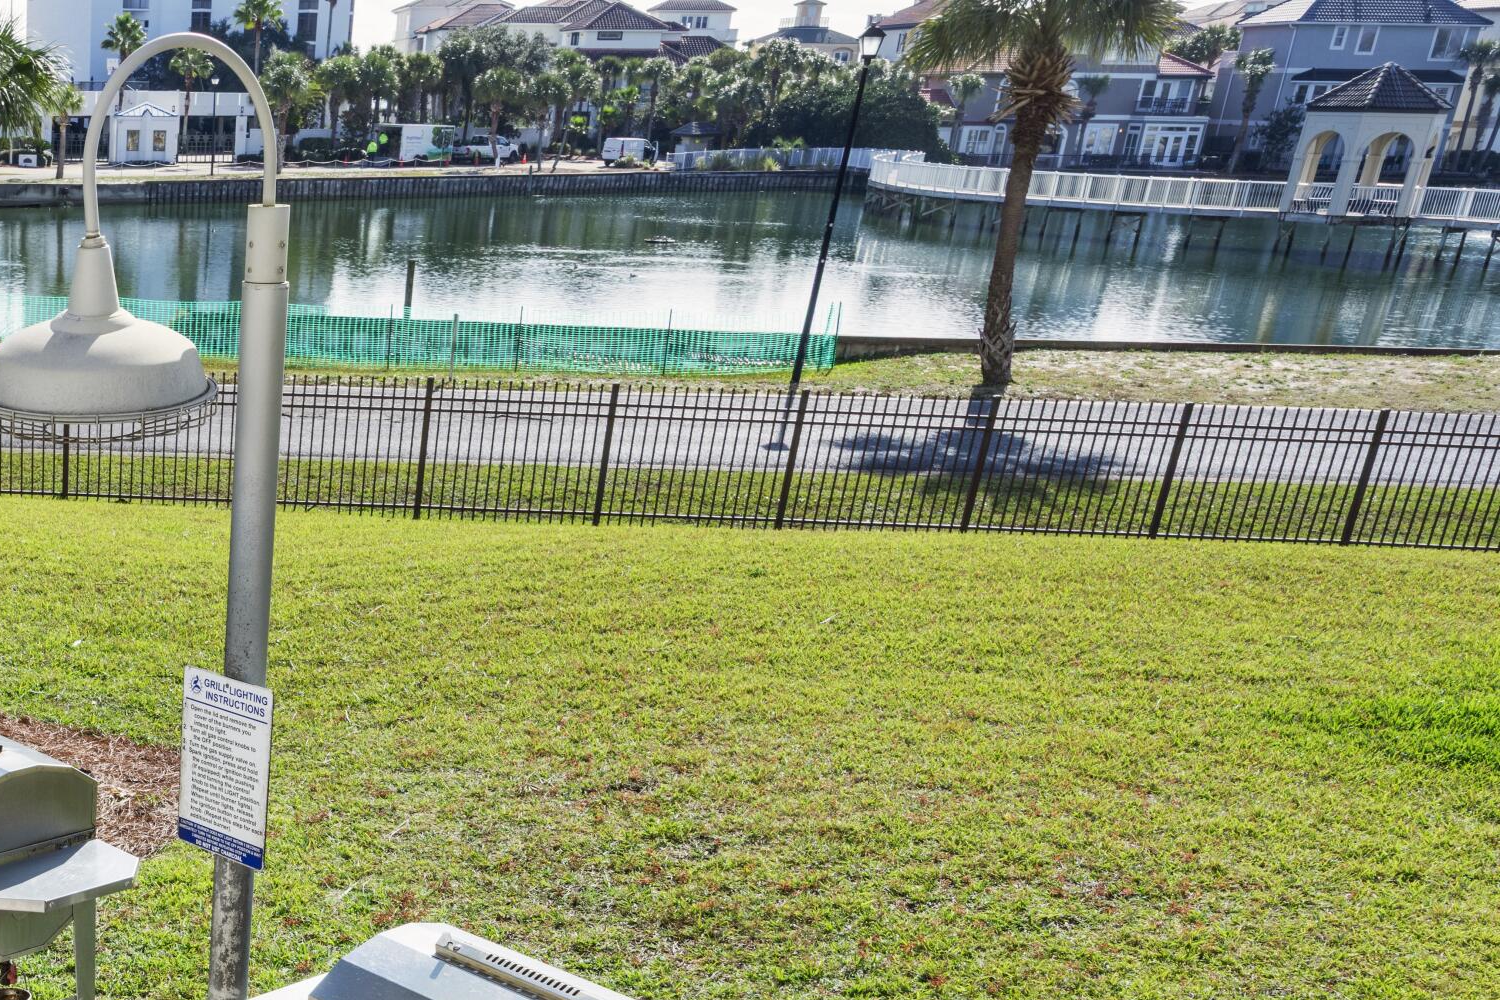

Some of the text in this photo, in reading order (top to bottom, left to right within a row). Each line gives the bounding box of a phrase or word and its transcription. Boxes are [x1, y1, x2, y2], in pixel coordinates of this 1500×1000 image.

[204, 678, 268, 706] GRILL LIGHTING
[191, 704, 203, 714] Open
[219, 713, 228, 721] and
[229, 717, 247, 727] remove
[205, 690, 265, 718] INSTRUCTIONS
[194, 720, 208, 729] intend
[194, 714, 207, 722] cover
[222, 722, 241, 733] burners
[242, 730, 251, 738] you
[190, 726, 200, 734] Turn
[217, 735, 234, 745] control
[235, 741, 250, 751] knobs
[189, 740, 199, 748] Turn
[209, 748, 217, 756] gas
[219, 751, 234, 761] supply
[236, 756, 248, 765] valve
[189, 747, 201, 757] Spark
[223, 760, 236, 769] press
[237, 764, 246, 772] and
[247, 768, 258, 776] hold
[201, 759, 218, 769] control
[225, 767, 243, 779] ignition
[243, 774, 259, 783] button
[222, 773, 234, 782] while
[235, 778, 255, 790] pushing
[192, 777, 203, 786] knob
[225, 788, 239, 798] LIGHT
[207, 775, 223, 786] turning
[233, 784, 250, 795] control
[191, 791, 204, 800] When
[205, 796, 220, 806] burner
[236, 808, 254, 818] release
[210, 791, 220, 799] until
[221, 795, 237, 805] burner
[190, 812, 212, 824] additional
[199, 801, 216, 813] ignition
[217, 808, 232, 817] button
[240, 816, 256, 826] control
[232, 821, 242, 829] step
[203, 842, 211, 850] NOT
[212, 845, 220, 854] USE
[221, 849, 243, 862] CHARCOAL
